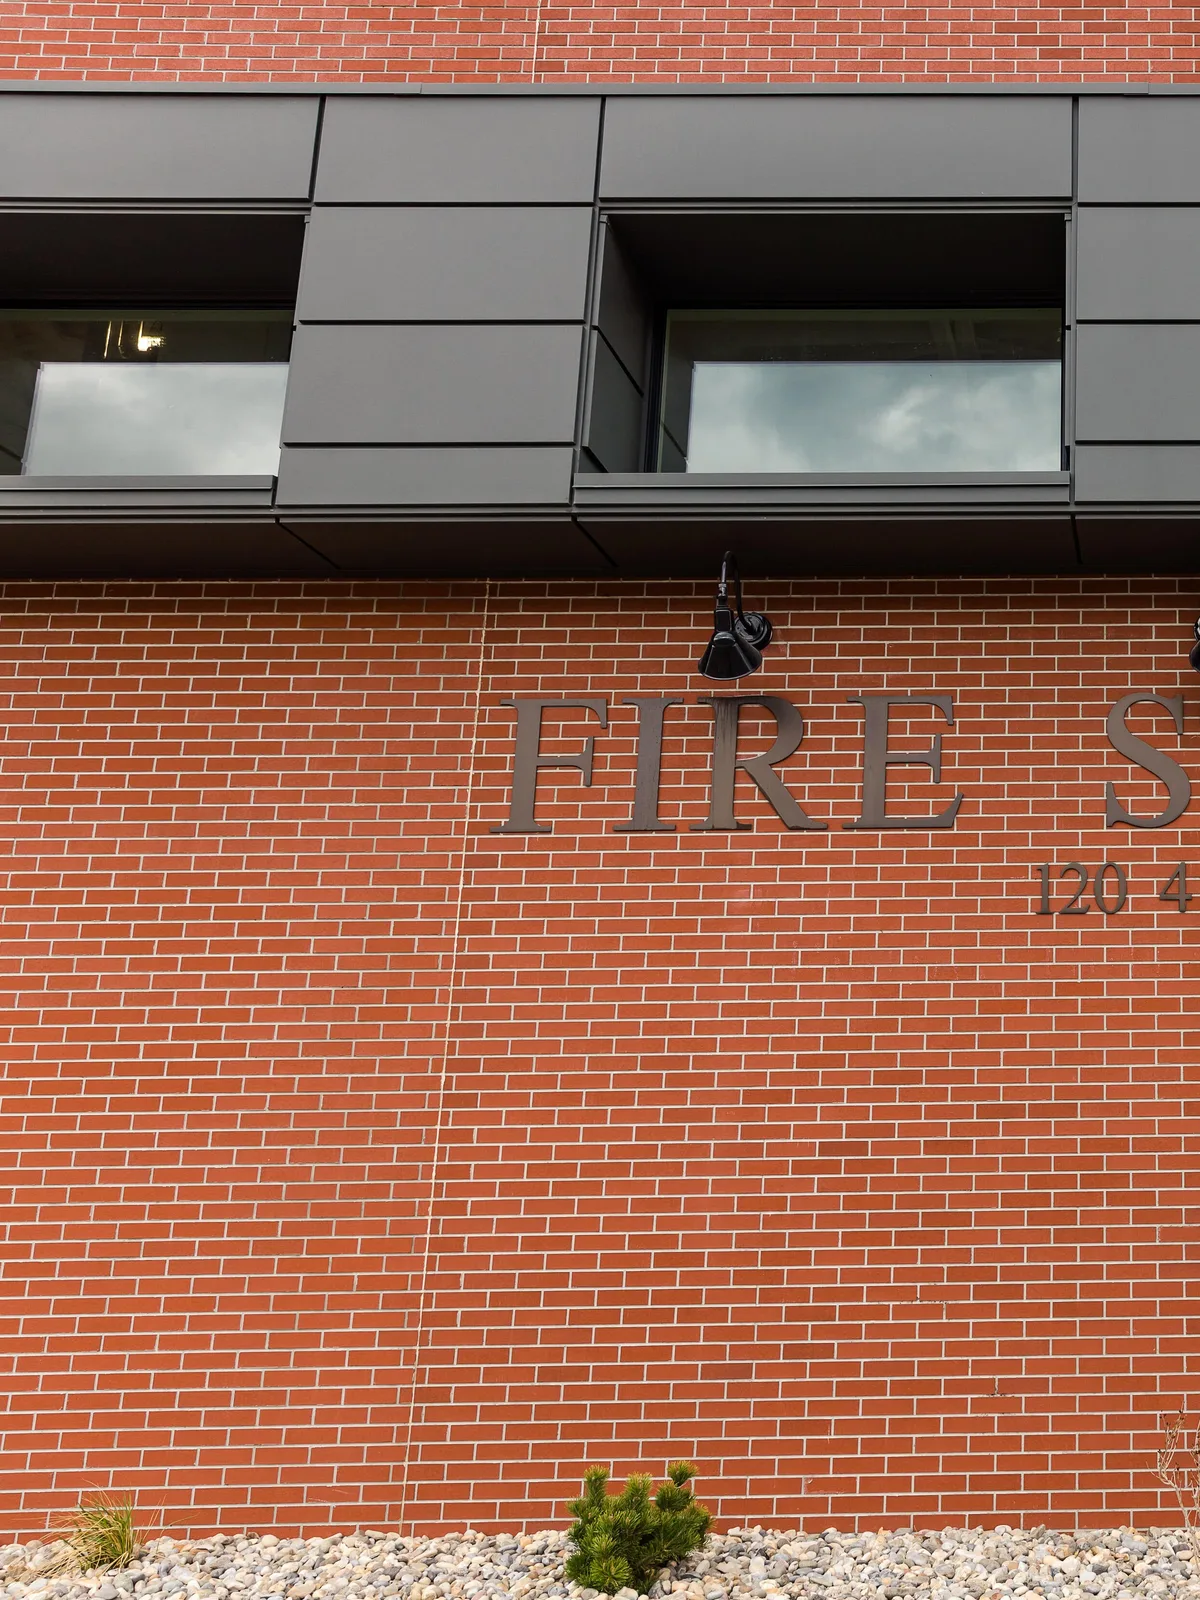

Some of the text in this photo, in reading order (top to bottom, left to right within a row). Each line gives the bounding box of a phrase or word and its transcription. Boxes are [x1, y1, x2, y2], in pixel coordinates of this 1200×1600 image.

[489, 695, 965, 833] FIRE
[1035, 862, 1128, 915] 120
[1159, 861, 1193, 913] 4
